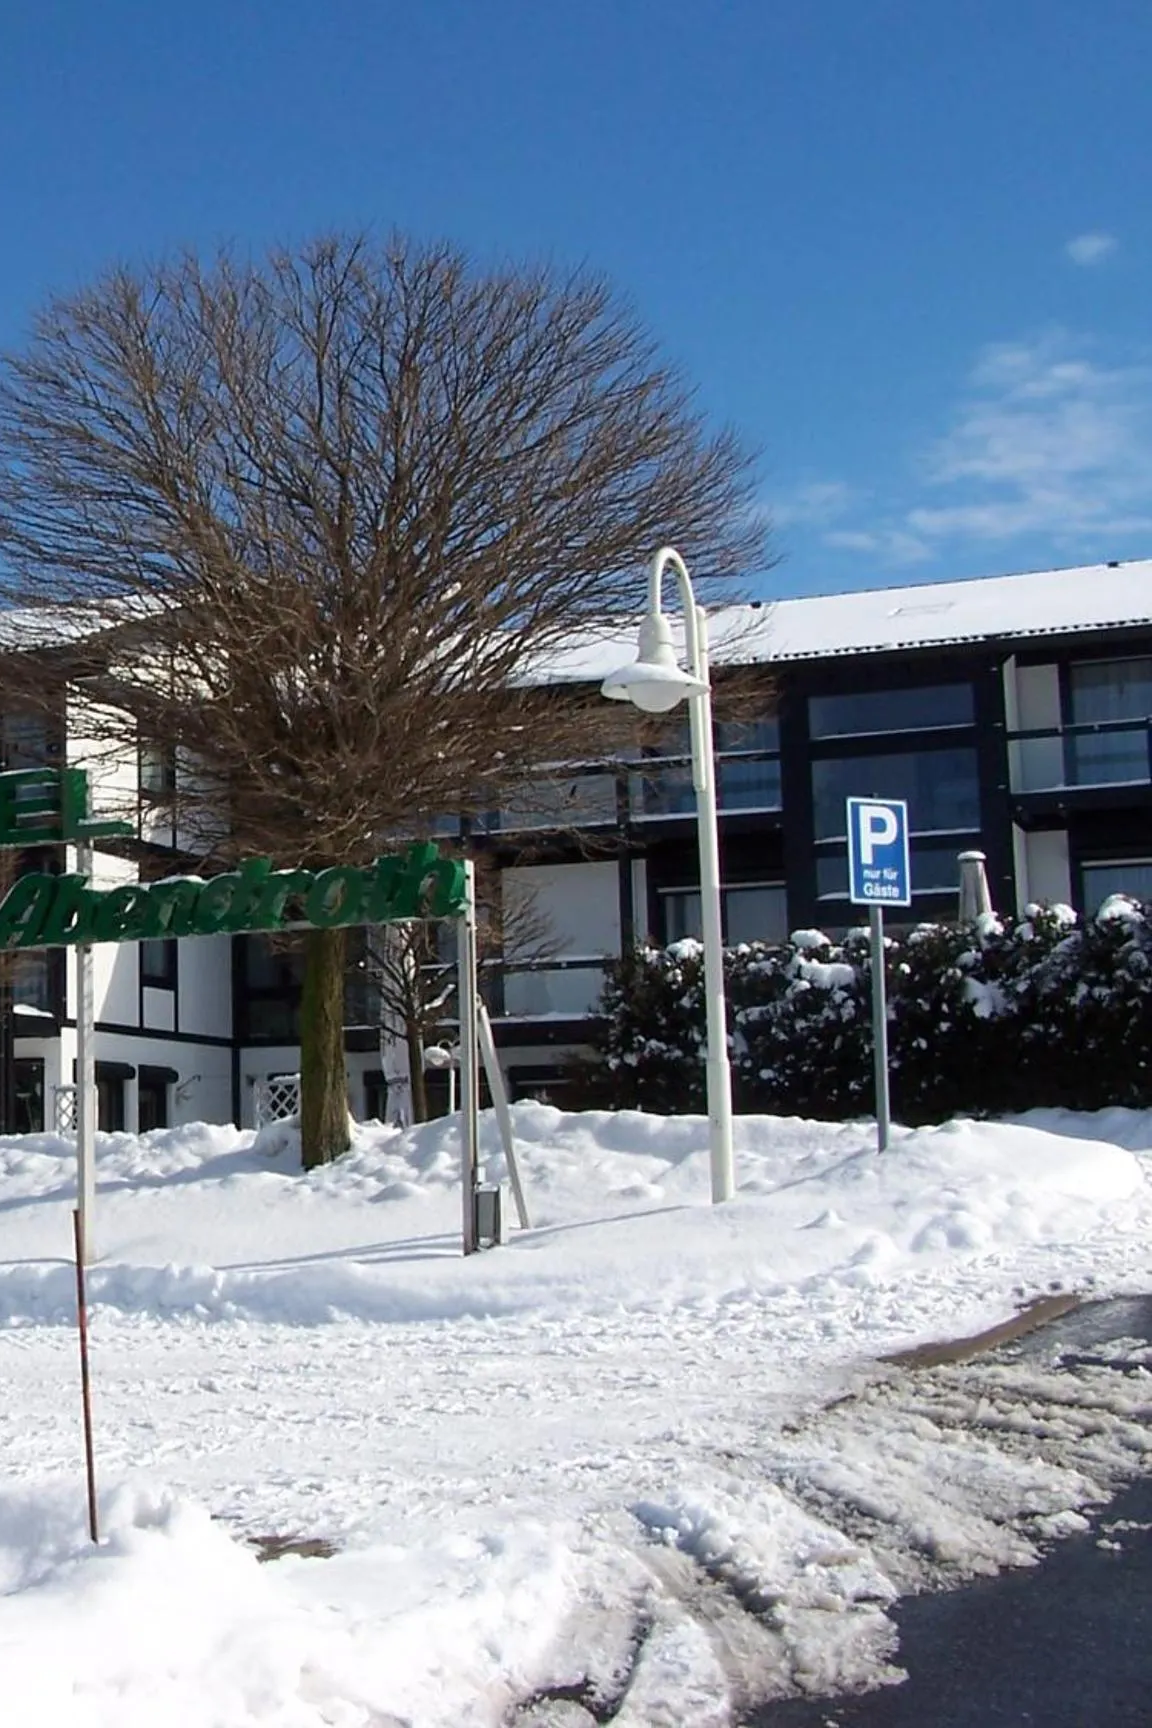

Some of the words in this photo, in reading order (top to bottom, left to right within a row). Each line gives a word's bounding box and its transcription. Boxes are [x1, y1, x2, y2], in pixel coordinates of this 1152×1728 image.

[859, 805, 898, 865] P
[863, 869, 880, 879] nur
[883, 867, 898, 880] für
[863, 882, 900, 898] Gäste
